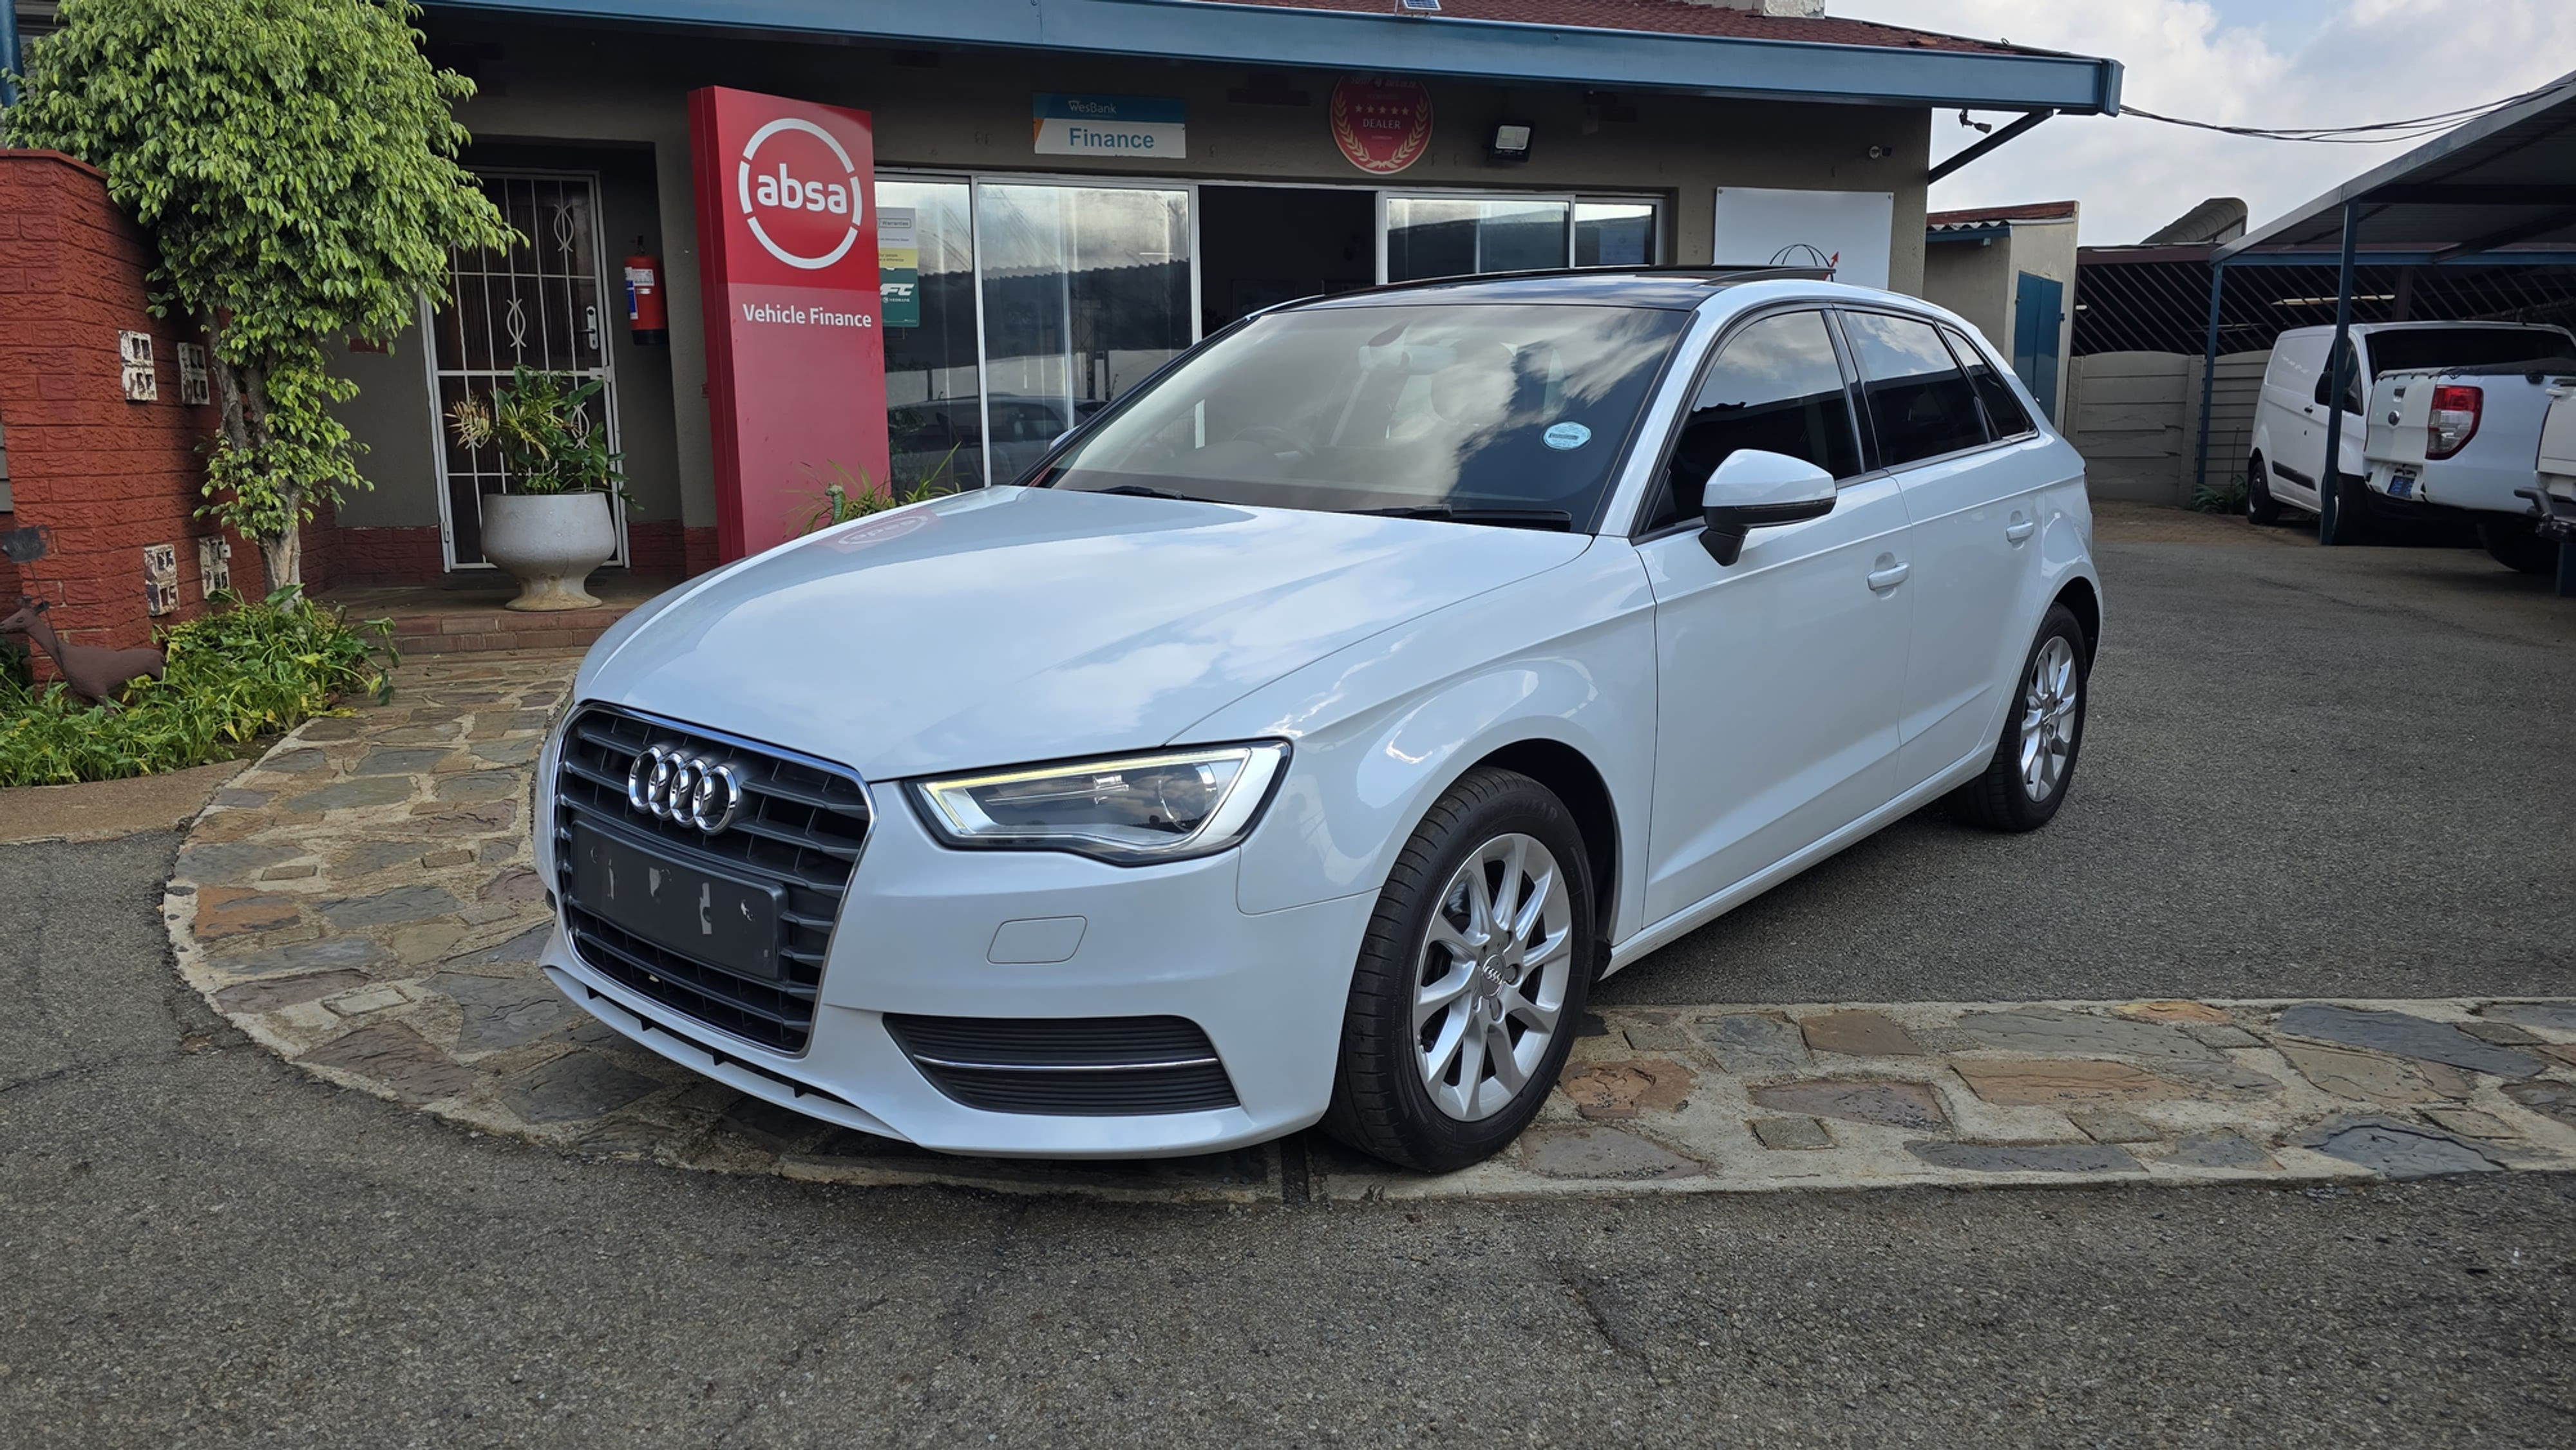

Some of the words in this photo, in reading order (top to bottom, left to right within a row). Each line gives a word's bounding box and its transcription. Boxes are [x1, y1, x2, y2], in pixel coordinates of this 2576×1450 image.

[1068, 100, 1117, 114] WesBank
[1363, 118, 1401, 129] DEALER
[1069, 127, 1155, 149] Finance
[756, 163, 848, 214] absa
[743, 303, 806, 324] Vehicle
[810, 307, 872, 328] Finance
